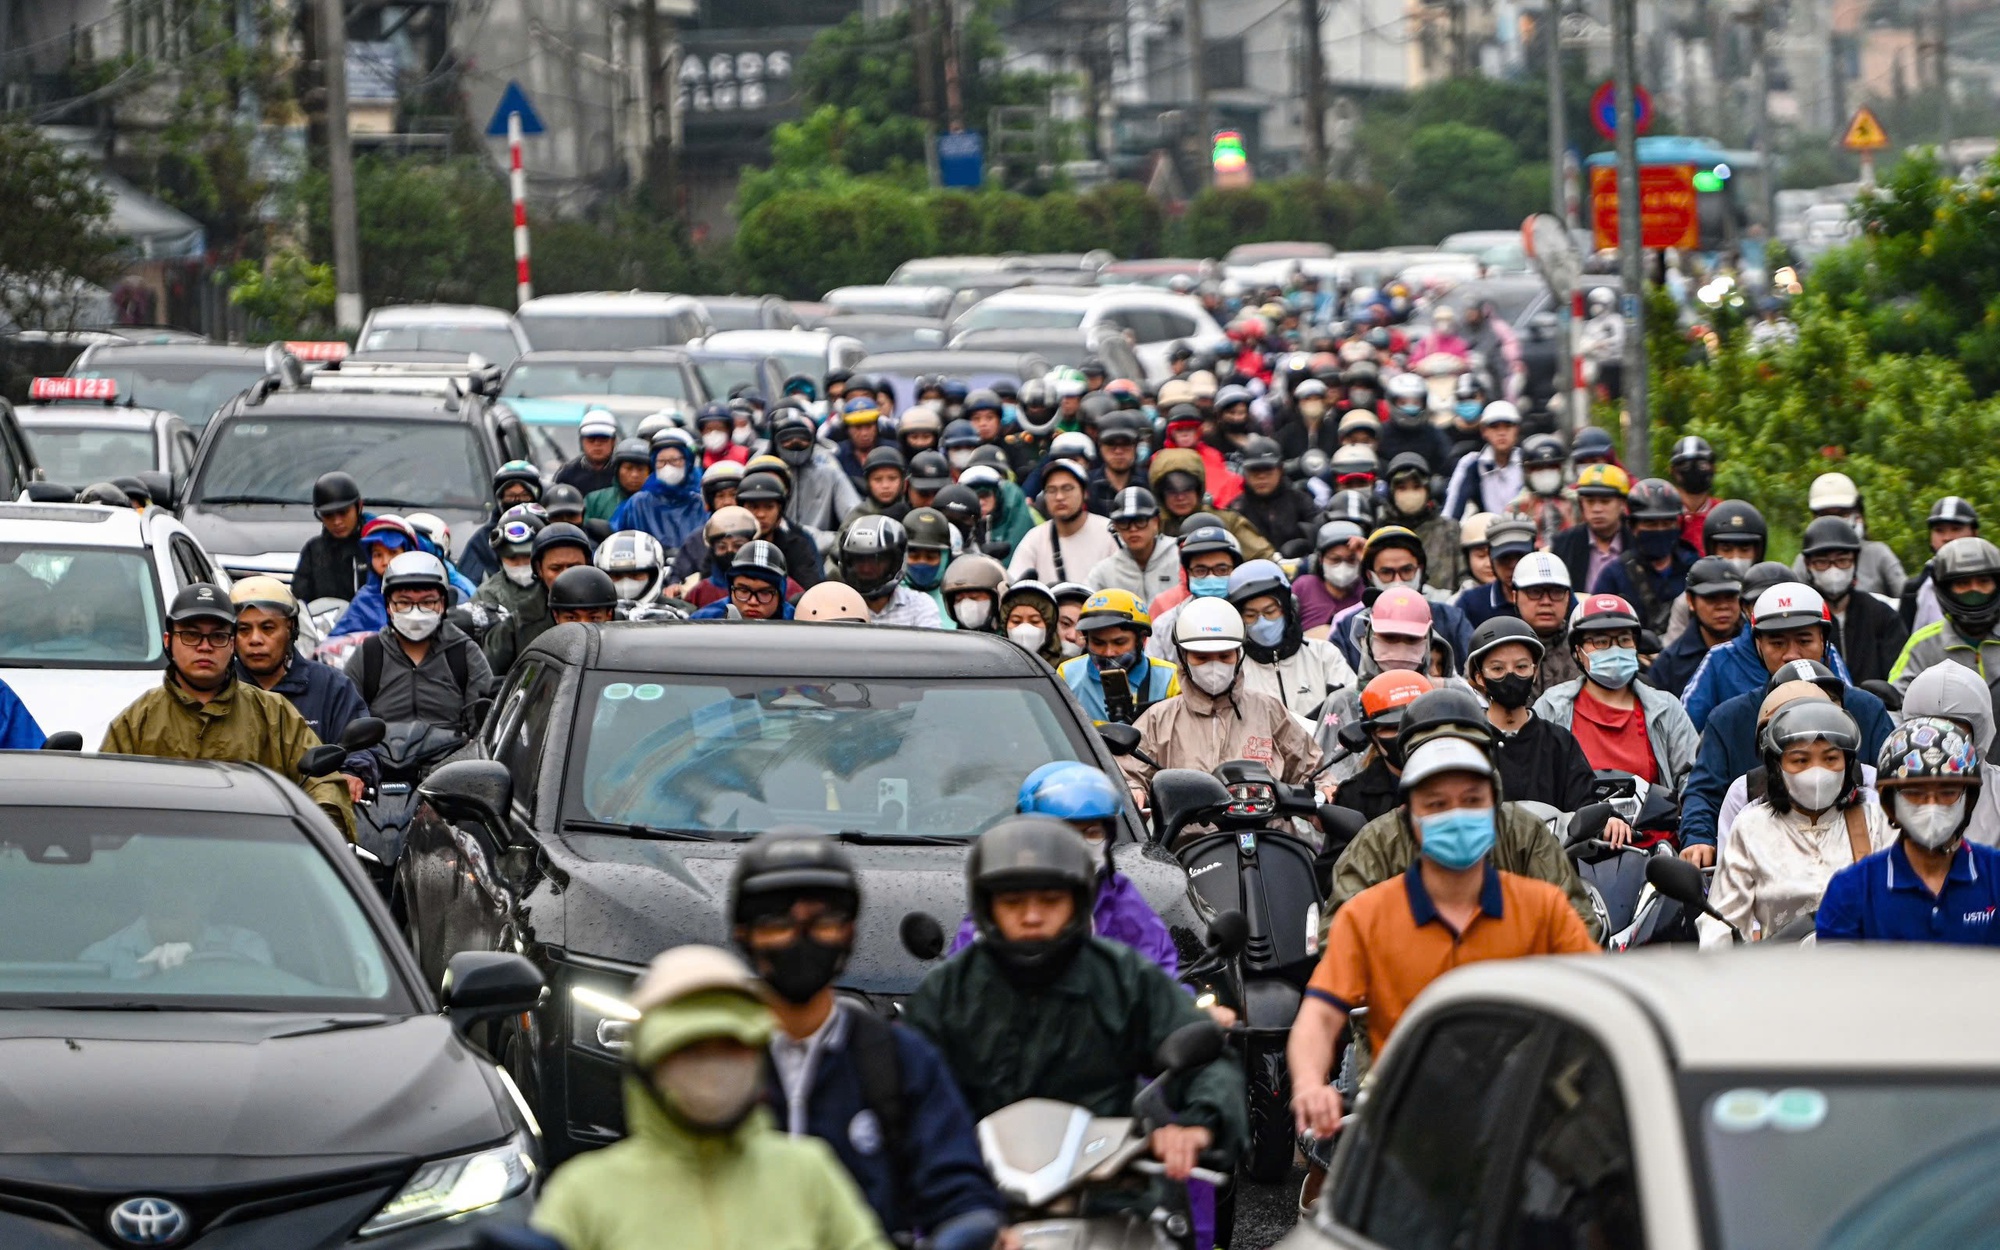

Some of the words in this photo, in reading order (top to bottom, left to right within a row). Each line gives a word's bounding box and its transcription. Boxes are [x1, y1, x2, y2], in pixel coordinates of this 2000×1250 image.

[39, 378, 70, 397] Taxi
[75, 378, 110, 397] 123
[1778, 597, 1792, 608] M
[1189, 862, 1222, 878] Vespa
[1963, 910, 1991, 922] USTH
